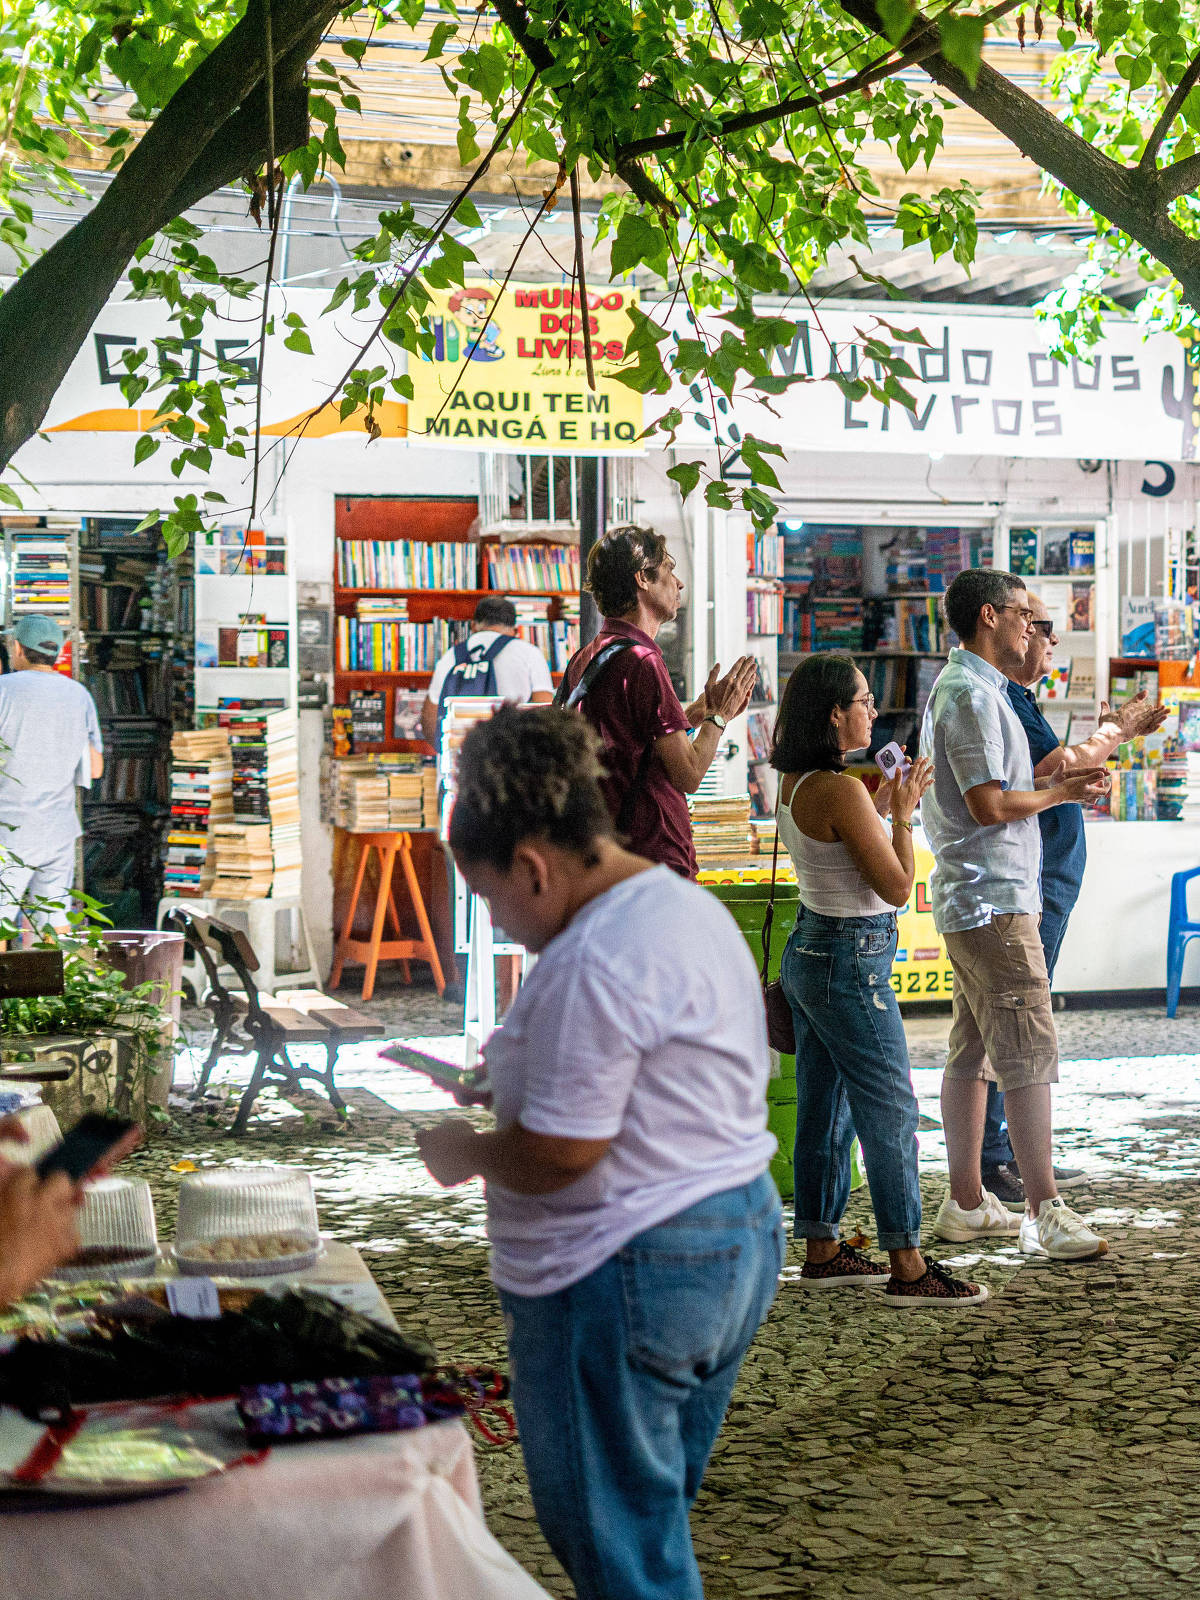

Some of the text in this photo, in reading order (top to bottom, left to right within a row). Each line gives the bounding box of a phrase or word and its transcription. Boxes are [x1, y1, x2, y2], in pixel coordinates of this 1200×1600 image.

[515, 288, 624, 311] MUNDO
[540, 313, 600, 336] DOS
[517, 338, 625, 361] LIVROS
[450, 391, 610, 413] AQUI TEM
[426, 414, 636, 442] MANGÁ E HQ
